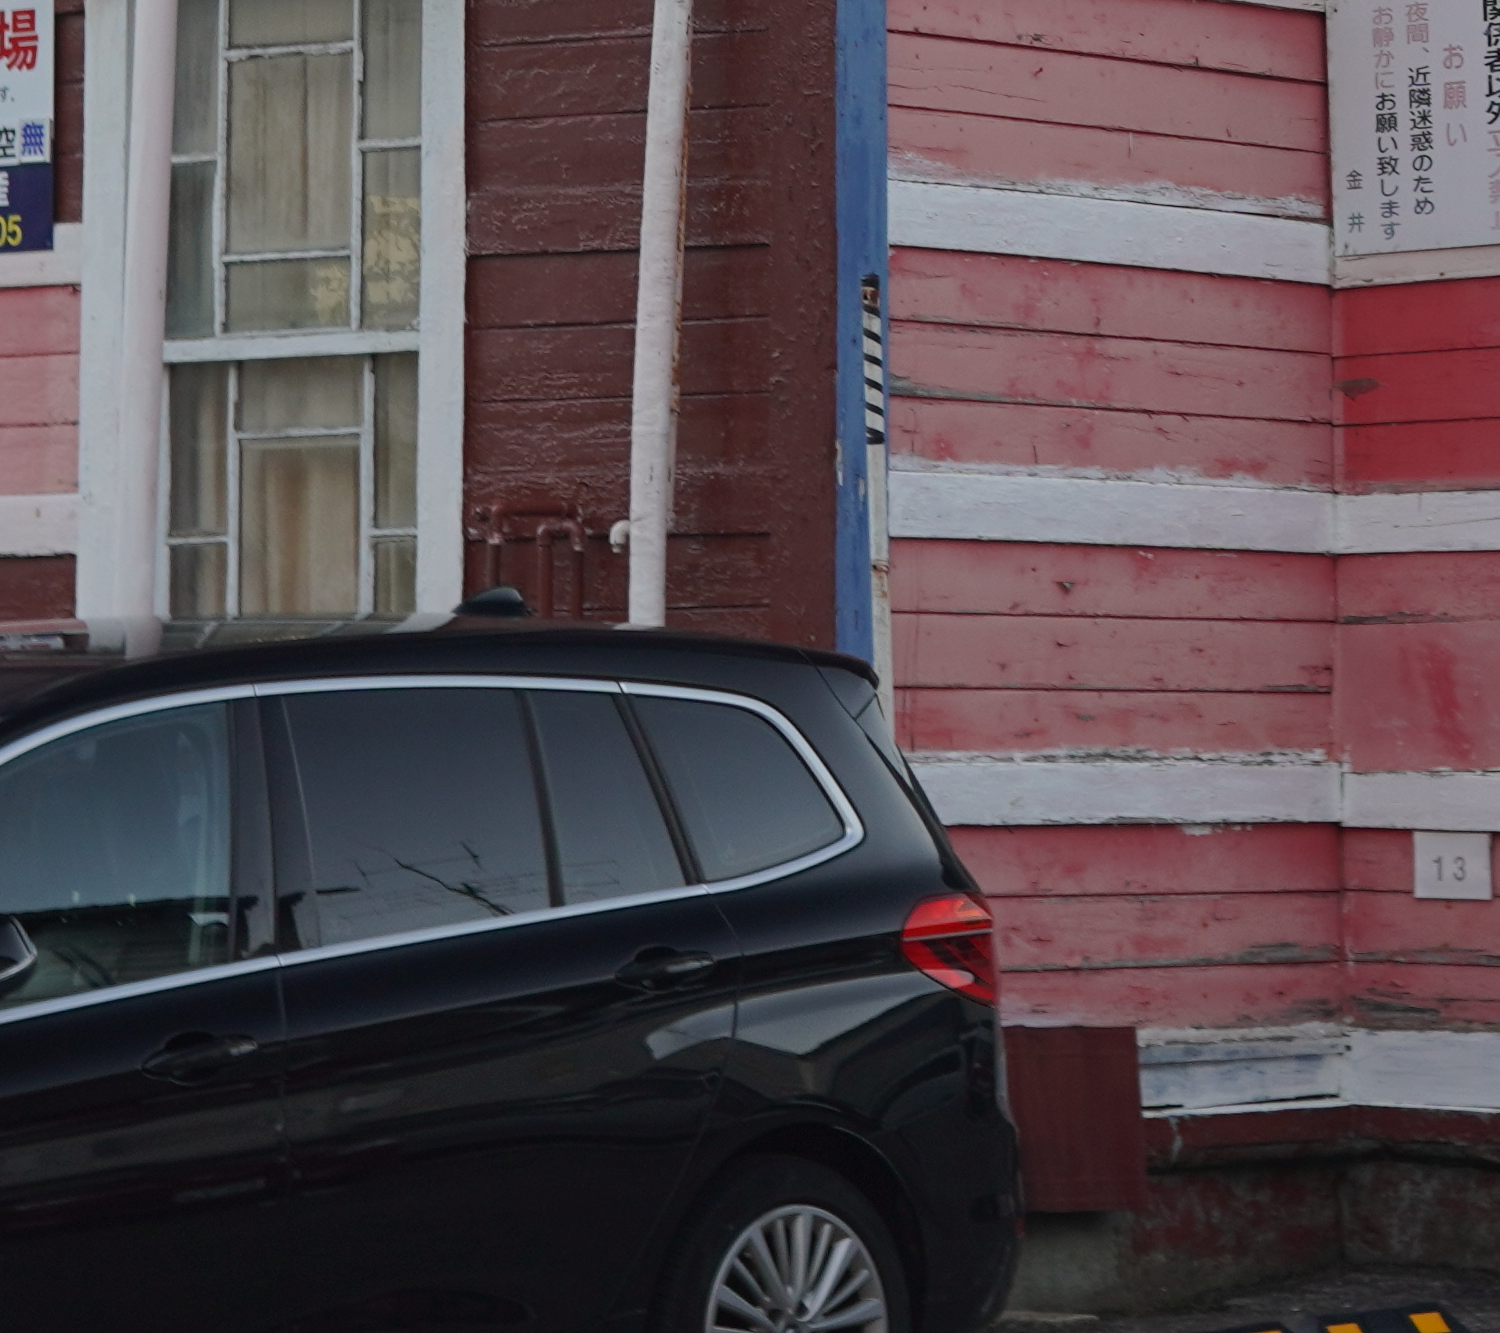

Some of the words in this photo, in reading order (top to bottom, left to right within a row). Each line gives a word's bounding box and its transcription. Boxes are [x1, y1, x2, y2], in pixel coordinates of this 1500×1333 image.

[1372, 6, 1401, 241] お静かにお願い致します
[1405, 1, 1436, 216] 夜間、近隣迷惑のため
[1442, 43, 1468, 148] お願い
[20, 121, 45, 157] 無
[1345, 169, 1365, 234] 金井
[1431, 856, 1467, 882] 13
